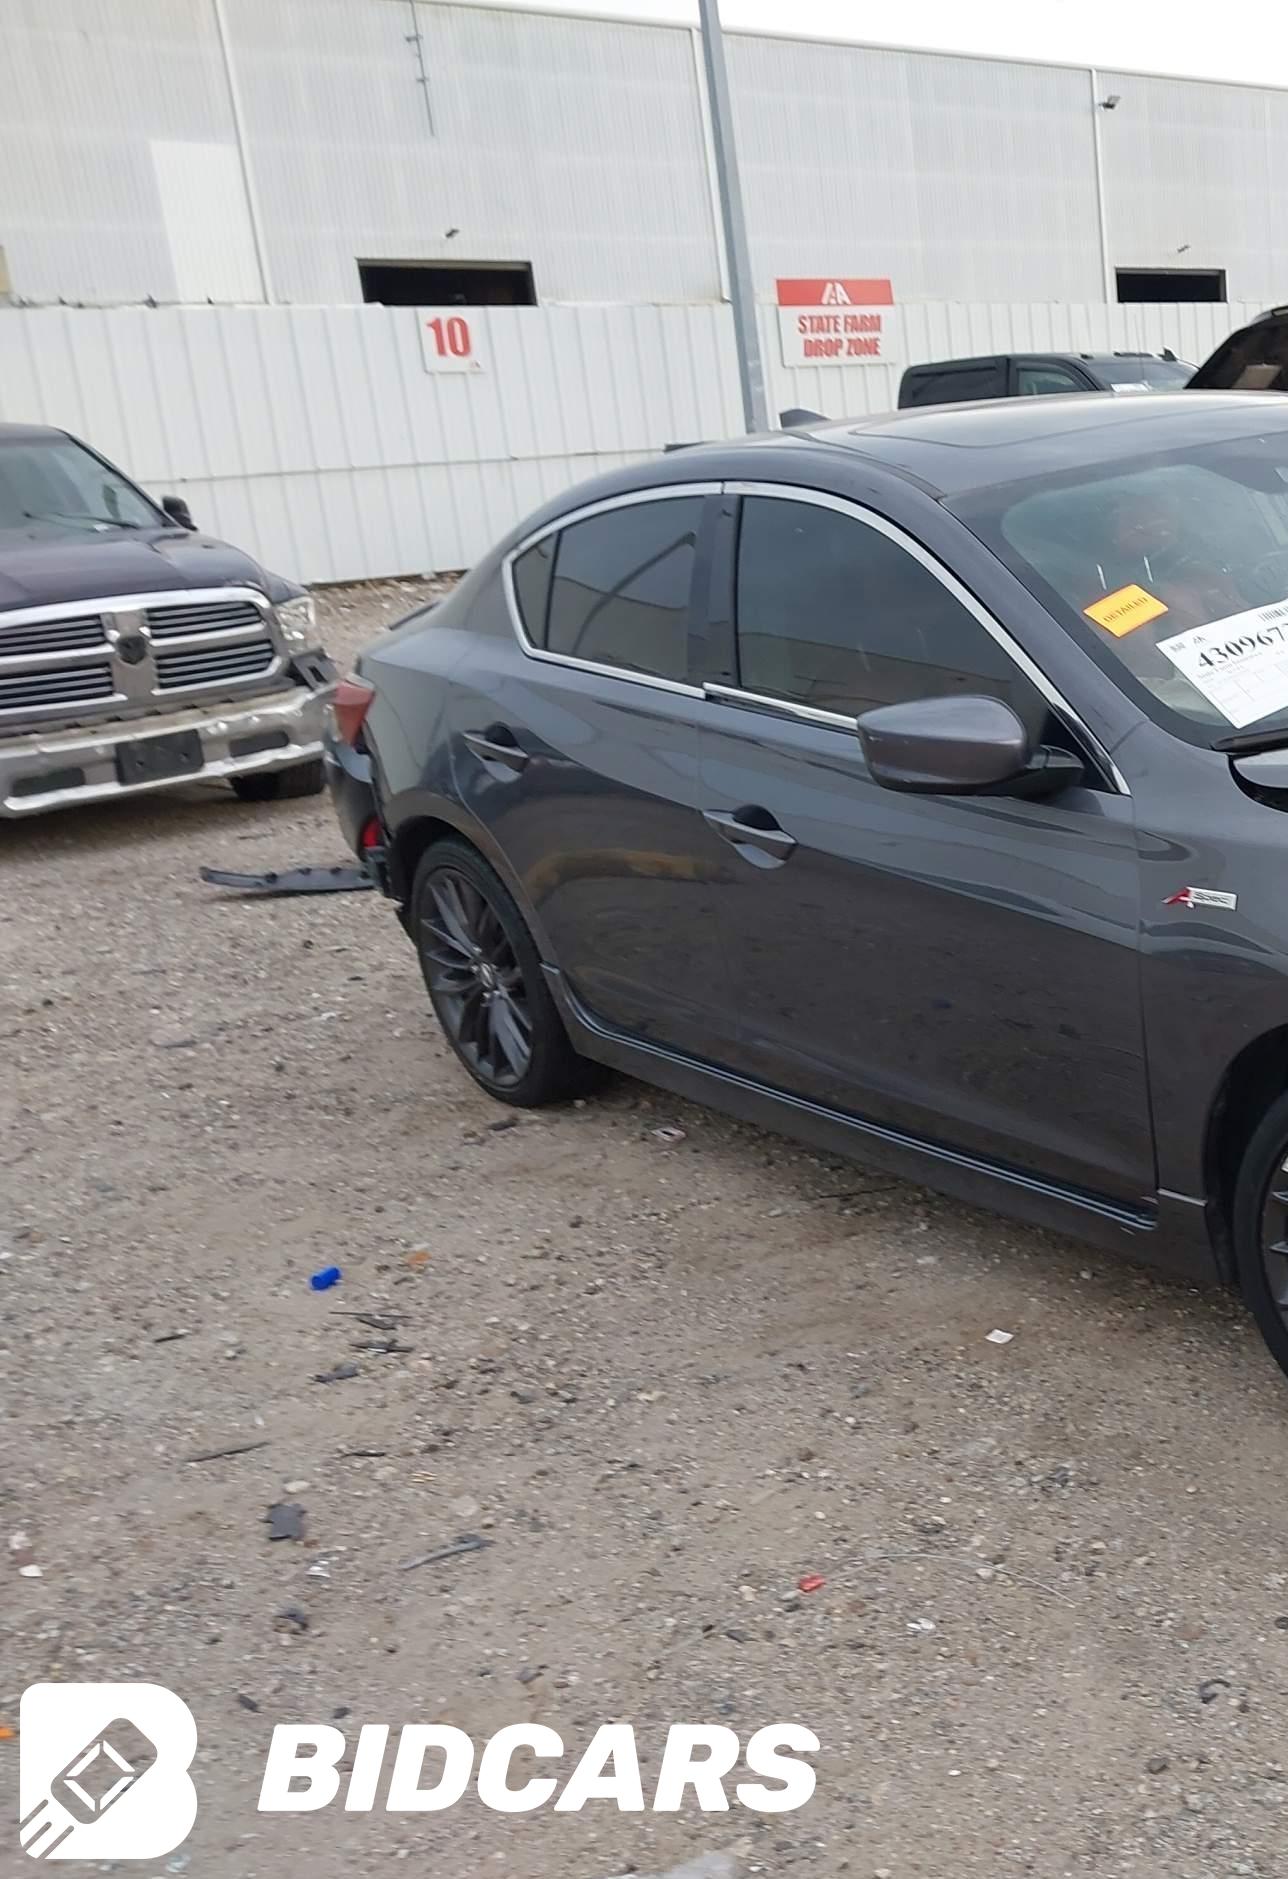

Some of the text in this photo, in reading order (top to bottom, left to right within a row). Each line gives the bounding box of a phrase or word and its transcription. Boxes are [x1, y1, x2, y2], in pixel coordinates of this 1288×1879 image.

[798, 314, 881, 333] STATE FARM
[426, 317, 471, 356] 10
[804, 338, 880, 357] DROP ZONE
